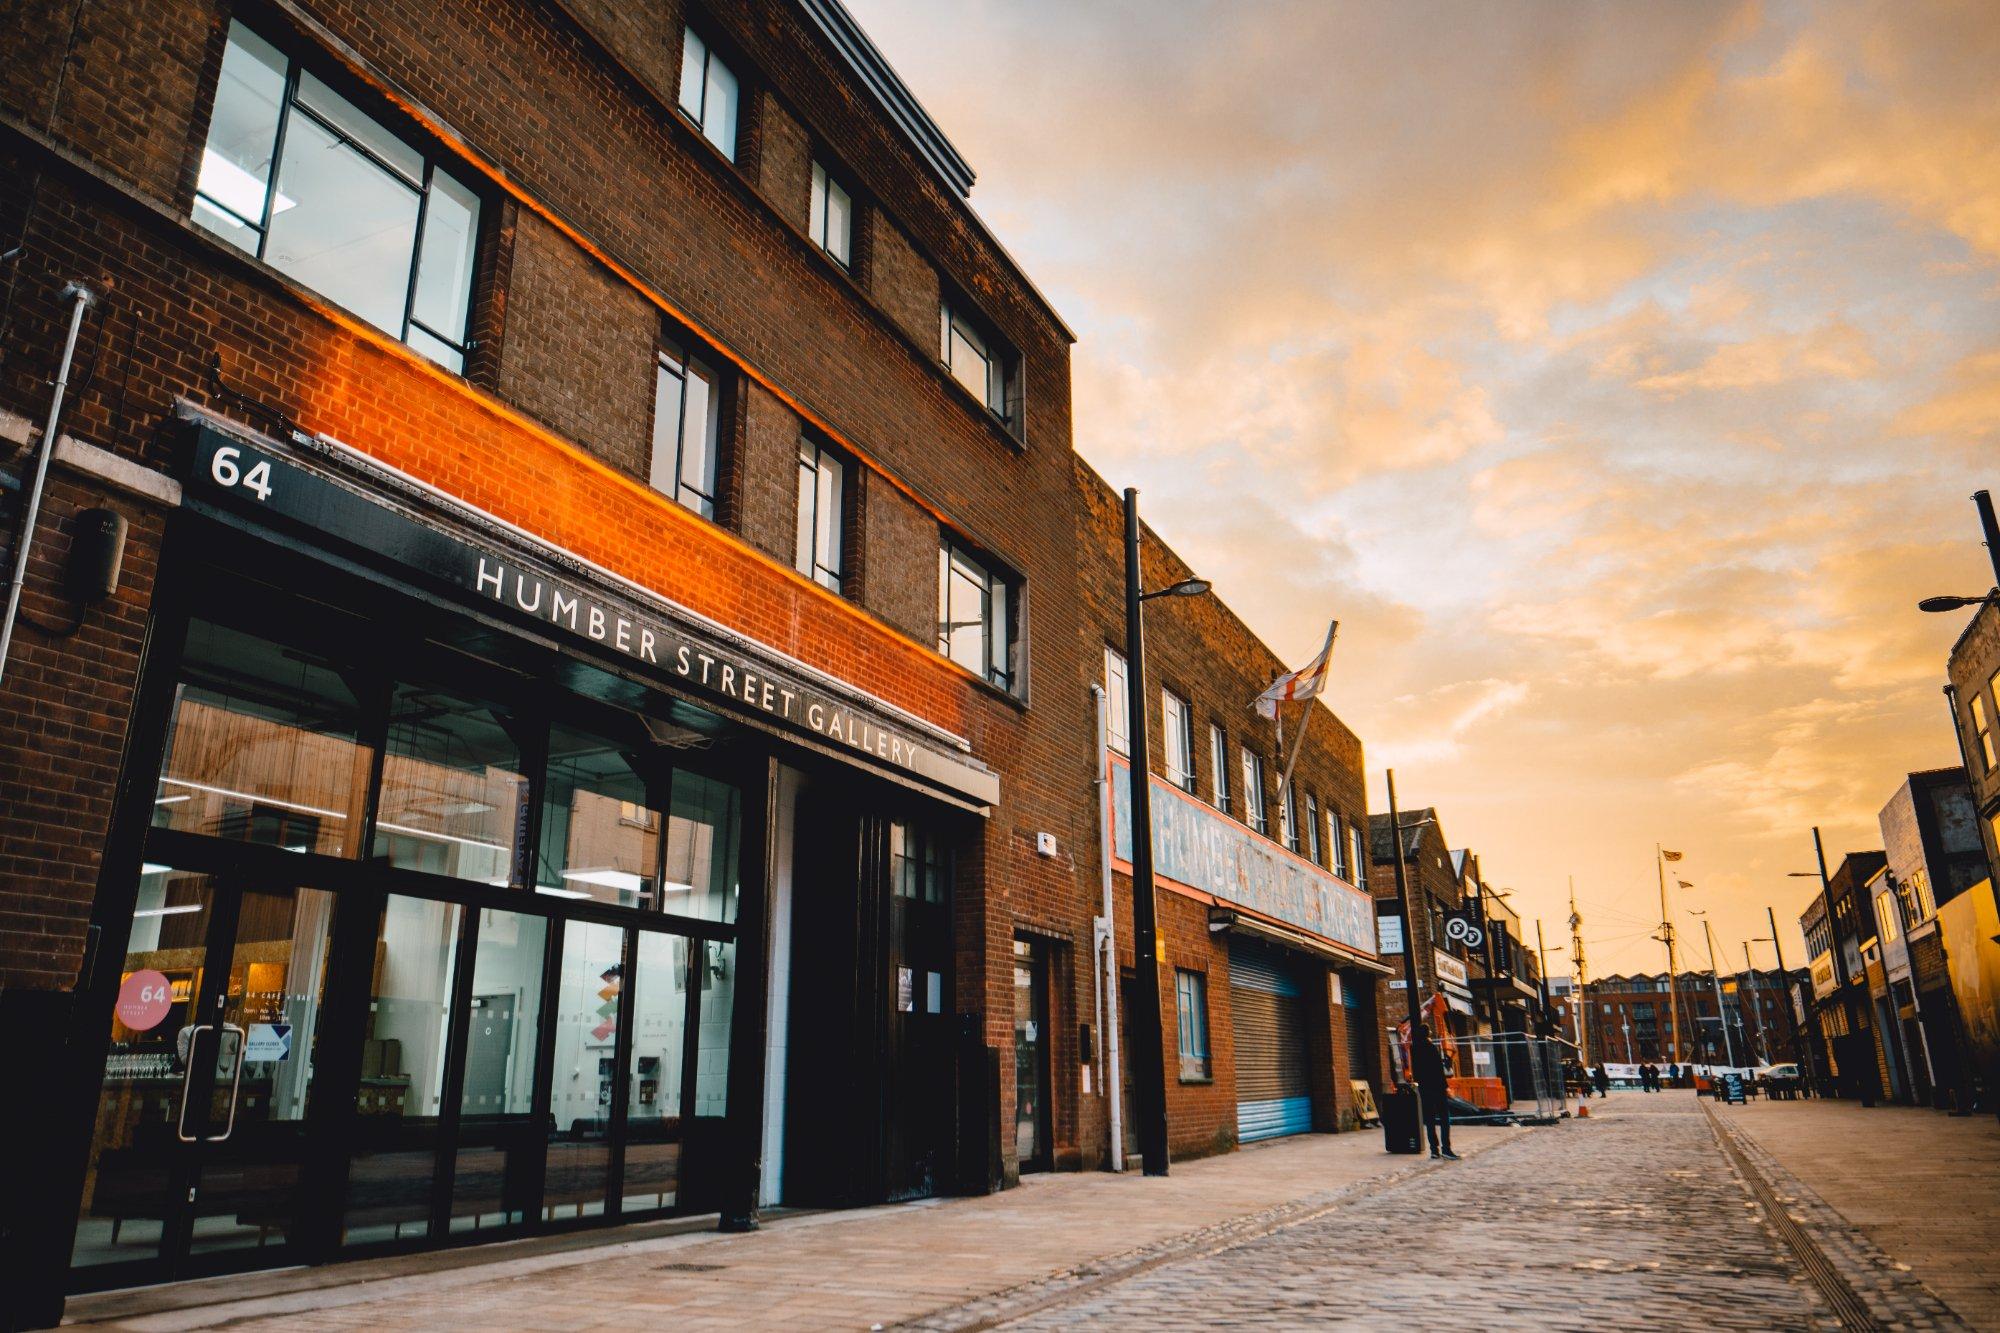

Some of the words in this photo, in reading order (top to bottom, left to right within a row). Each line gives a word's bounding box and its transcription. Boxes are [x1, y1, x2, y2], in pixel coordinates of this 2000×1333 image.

[211, 446, 272, 502] 64
[475, 557, 657, 665] HUMBER
[677, 645, 796, 717] STREET
[808, 703, 917, 769] GALLERY
[140, 985, 166, 1004] 64
